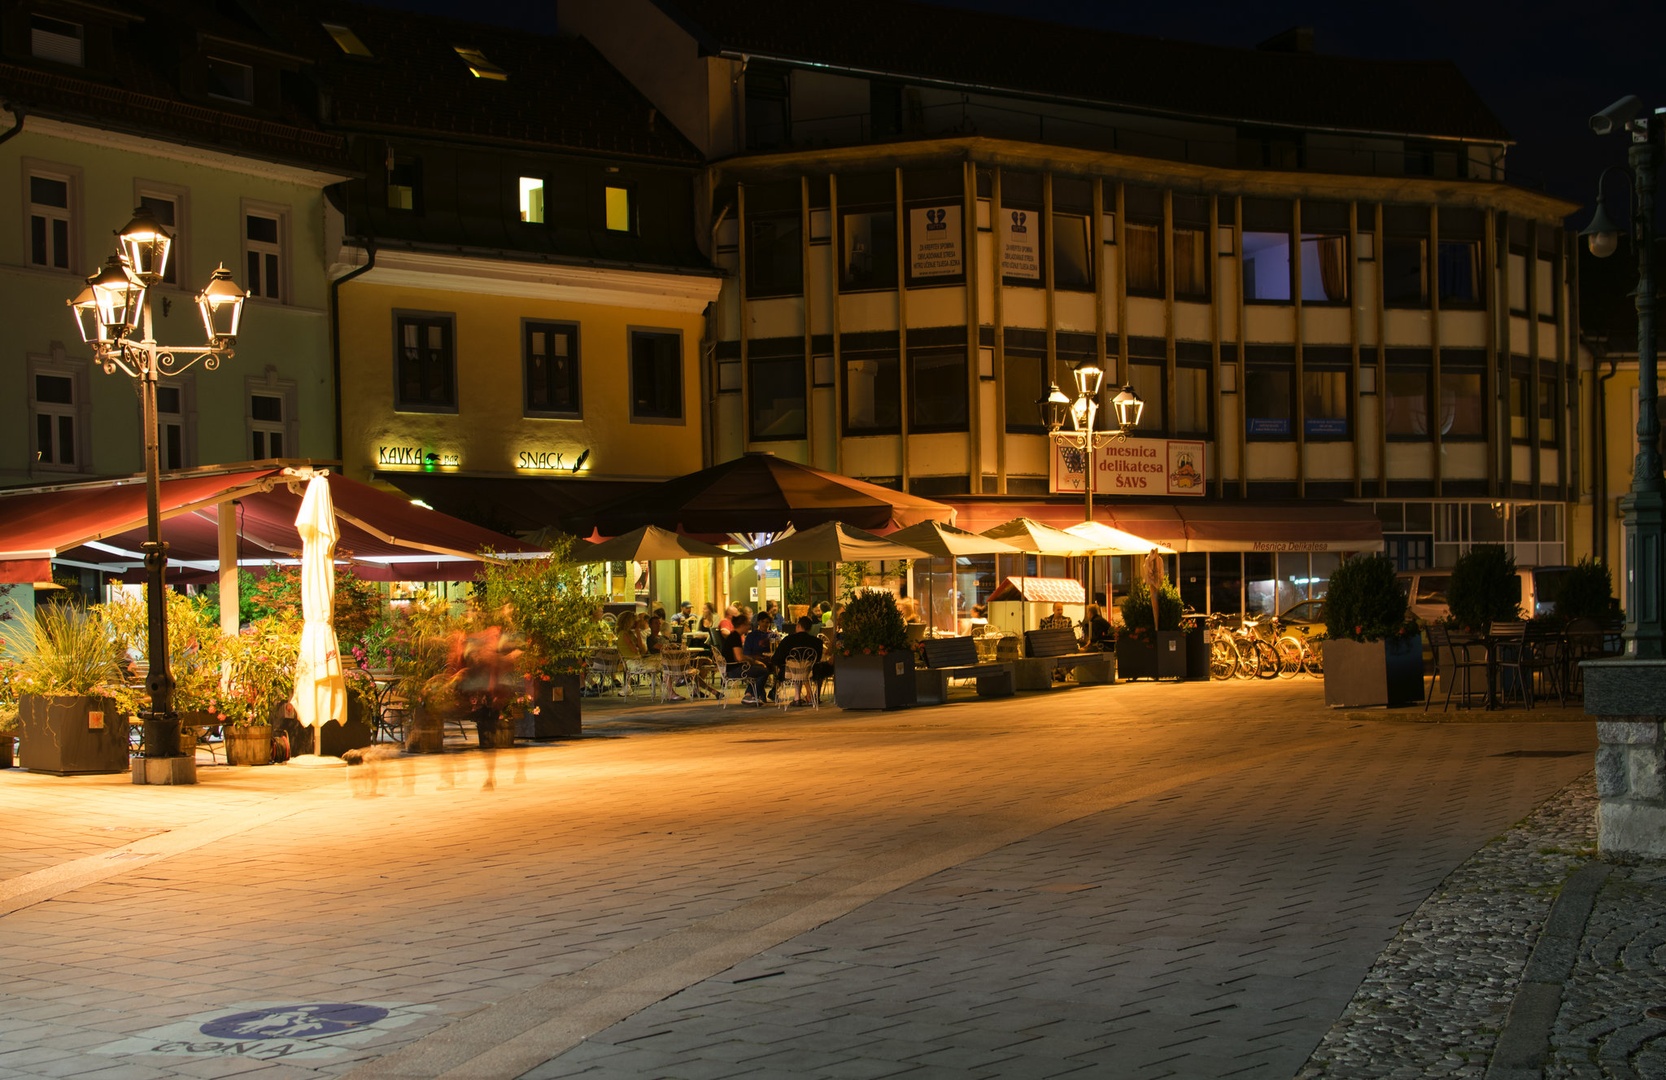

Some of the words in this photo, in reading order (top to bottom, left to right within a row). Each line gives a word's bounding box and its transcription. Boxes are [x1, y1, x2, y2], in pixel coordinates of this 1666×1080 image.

[380, 447, 422, 465] KAVKA
[1106, 446, 1157, 458] mesnica
[519, 451, 564, 469] SNACK
[1099, 459, 1164, 473] delikatesa
[1116, 474, 1147, 488] ŠAVS
[1253, 542, 1286, 551] Mesnica
[1288, 542, 1328, 551] Delikatesa
[151, 1041, 294, 1055] CONA
